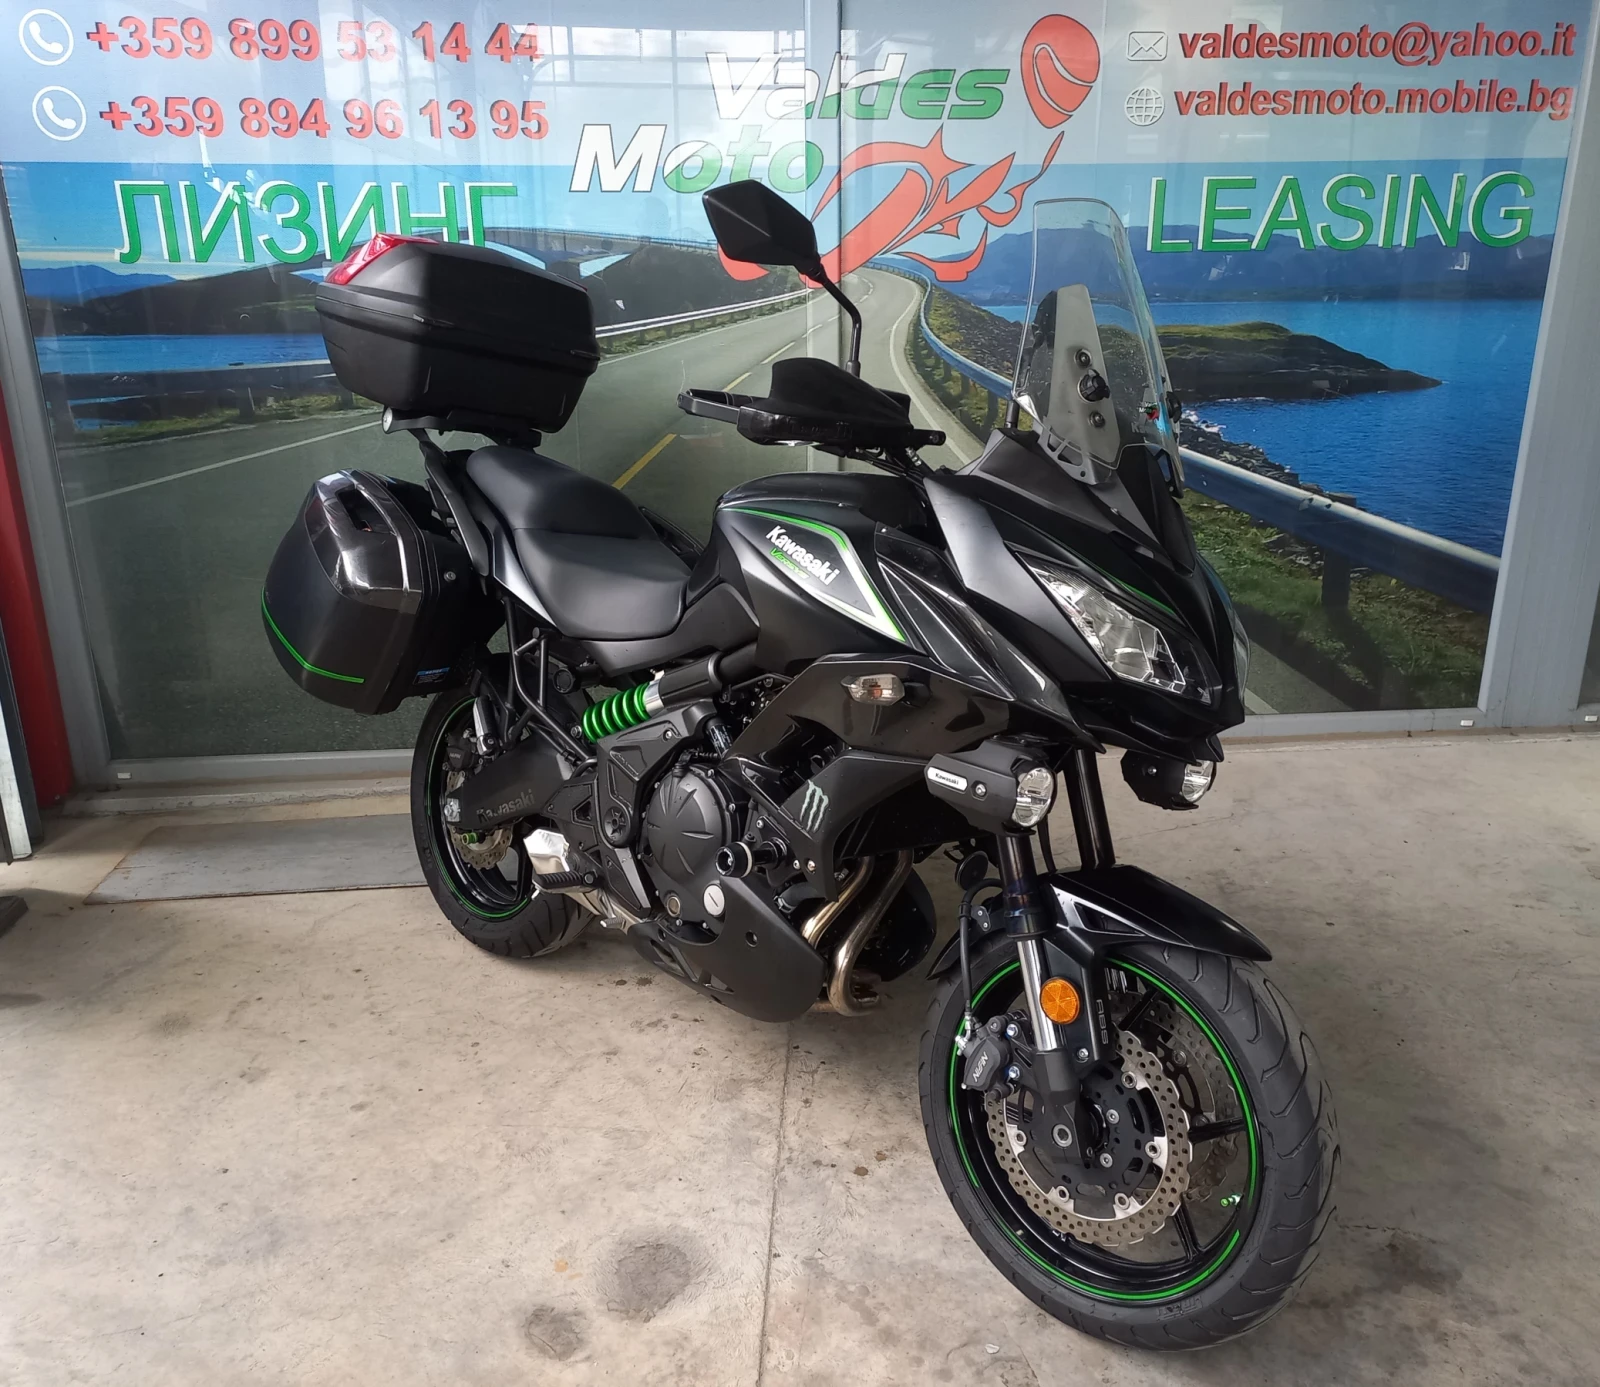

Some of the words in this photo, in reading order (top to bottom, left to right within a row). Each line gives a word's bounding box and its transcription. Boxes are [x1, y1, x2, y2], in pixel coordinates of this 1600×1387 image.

[86, 16, 213, 59] +359
[228, 18, 320, 61] 899
[337, 20, 396, 62] 53
[412, 21, 471, 63] 14
[484, 22, 544, 63] 44
[1179, 22, 1577, 66] valdesmoto@yahoo.it
[705, 51, 1010, 120] Valdes
[1174, 79, 1575, 120] valdesmoto.mobile.bg
[100, 95, 225, 138] +359
[239, 97, 331, 139] 894
[343, 99, 404, 139] 96
[419, 99, 477, 139] 13
[489, 100, 549, 140] 95
[569, 123, 824, 194] Moto
[114, 179, 518, 264] ЛИЗИНГ
[1146, 170, 1535, 253] LEASING
[765, 525, 841, 586] Kawasaki
[935, 772, 959, 785] Kawasaki
[476, 788, 535, 824] Kawasaki
[1096, 999, 1109, 1045] ABS
